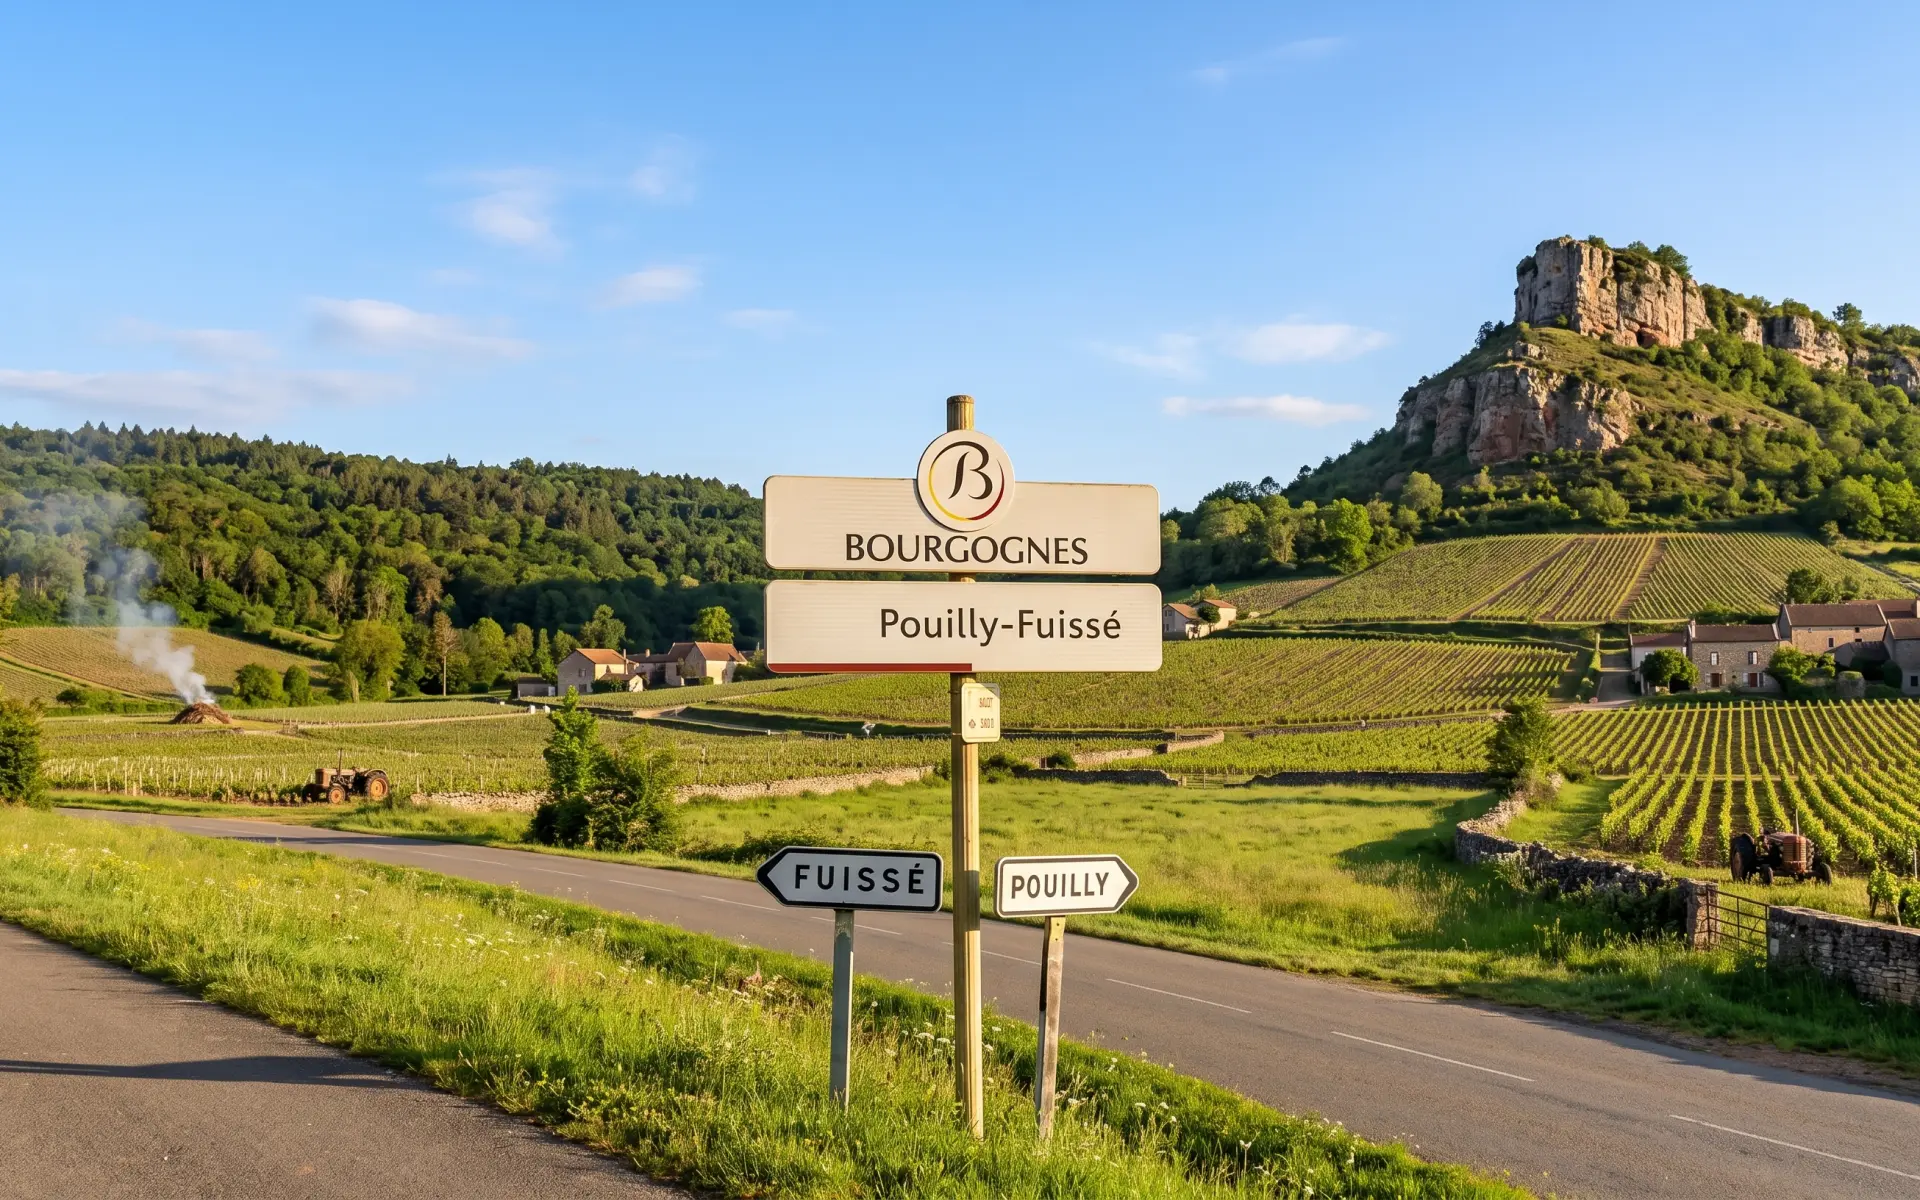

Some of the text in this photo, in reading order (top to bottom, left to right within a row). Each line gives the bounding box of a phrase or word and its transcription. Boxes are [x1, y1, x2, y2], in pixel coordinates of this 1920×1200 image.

[934, 440, 994, 500] B
[846, 533, 1089, 565] BOURGOGNES
[881, 607, 1121, 647] Pouilly-Fuissé
[794, 862, 925, 895] FUISSÉ
[1011, 872, 1110, 899] POUILLY
